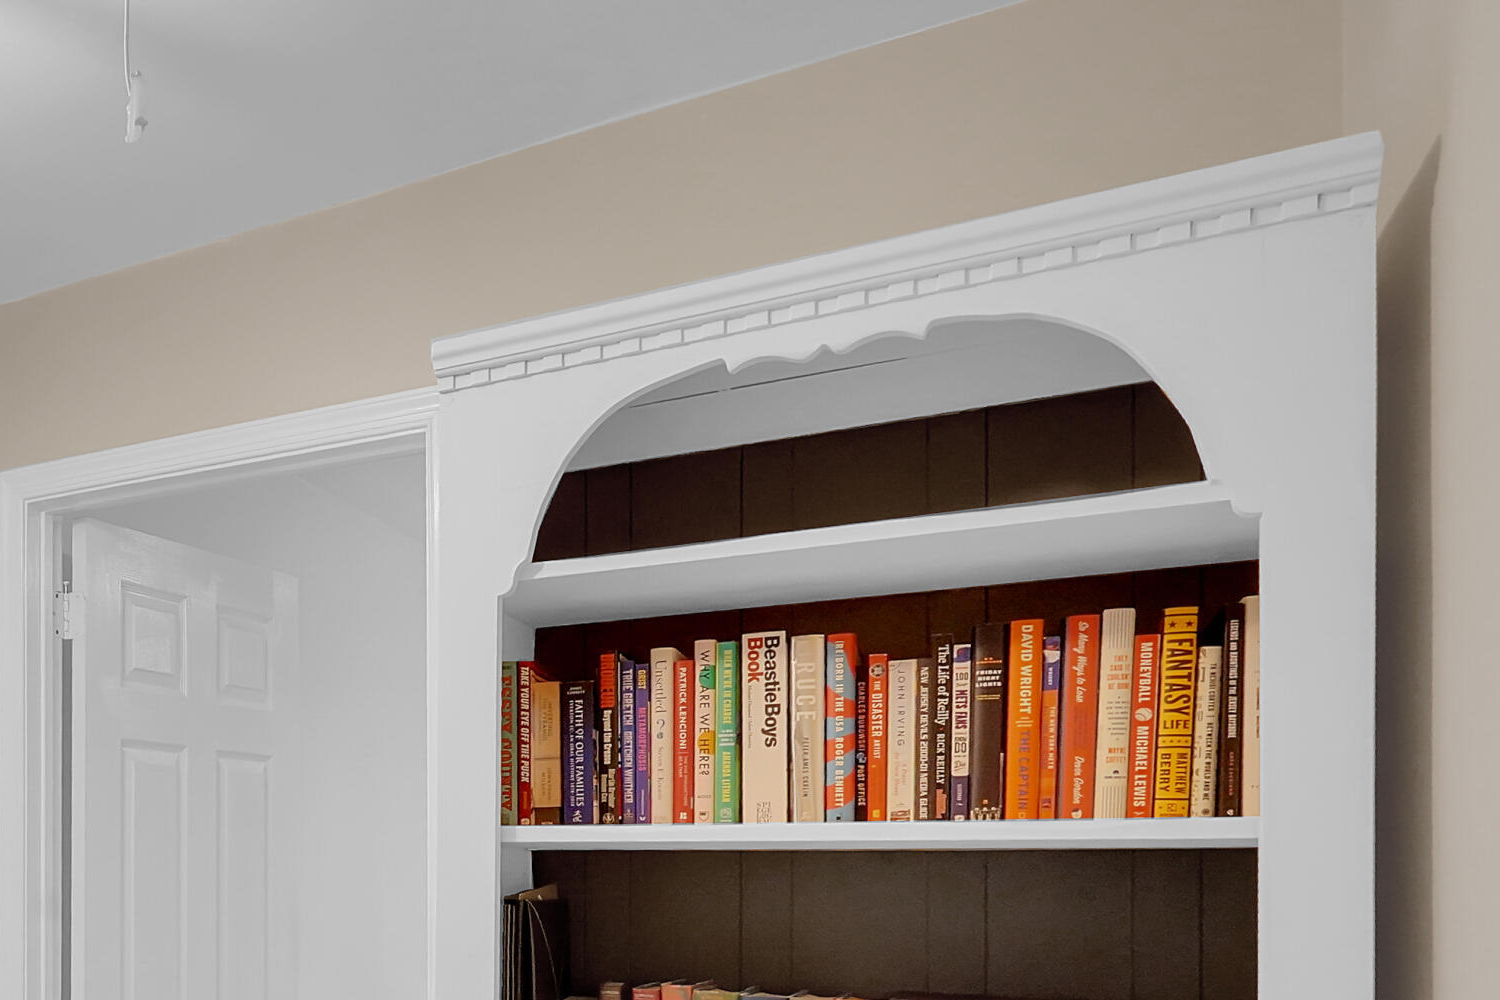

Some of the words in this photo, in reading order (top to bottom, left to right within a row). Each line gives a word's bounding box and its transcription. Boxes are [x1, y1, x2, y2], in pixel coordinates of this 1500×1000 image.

[937, 643, 949, 664] The
[1020, 624, 1034, 661] DAVID
[699, 650, 710, 683] WHY
[747, 637, 764, 684] Book
[920, 666, 929, 683] NEW
[1138, 641, 1153, 703] MONEYBALL
[521, 666, 530, 686] TAKE
[622, 669, 634, 692] TRUE
[654, 659, 667, 713] Unsettled
[679, 667, 687, 703] PATRICK
[872, 681, 881, 691] THE
[897, 669, 906, 700] JOHN
[937, 665, 949, 685] Life
[955, 672, 969, 681] 100
[1164, 638, 1195, 716] FANTASY
[521, 687, 530, 710] YOUR
[699, 685, 710, 709] ARE
[764, 635, 781, 748] BeastieBoys
[857, 682, 866, 713] CHARLES
[920, 685, 929, 713] JERSEY
[937, 686, 947, 697] of
[955, 689, 968, 709] METS
[1019, 665, 1033, 714] WRIGHT
[574, 699, 585, 727] FAITH
[622, 693, 634, 726] GRETCH
[835, 696, 844, 712] THE
[871, 693, 883, 737] DISASTER
[935, 698, 949, 726] Reilly
[520, 711, 530, 726] EYE
[679, 707, 687, 749] LENCIONI
[699, 714, 710, 733] WE
[835, 716, 844, 732] USA
[896, 705, 906, 747] IRVING
[919, 714, 929, 740] DEVILS
[955, 712, 968, 730] FANS
[1163, 720, 1190, 729] LIFE
[520, 727, 530, 742] OFF
[574, 728, 585, 741] OF
[857, 715, 866, 751] BUKOWSKI
[936, 733, 946, 754] RICK
[1018, 730, 1031, 755] THE
[520, 743, 530, 757] THE
[574, 742, 585, 763] OUR
[622, 731, 634, 769] GRETCHEN
[699, 739, 710, 775] HERE?
[835, 737, 844, 767] ROGER
[872, 739, 881, 759] ARTIST
[1134, 725, 1150, 774] MICHAEL
[520, 759, 530, 782] PUCK
[721, 751, 731, 777] AMANDA
[857, 765, 866, 781] POST
[936, 755, 946, 785] REILLY
[1160, 753, 1172, 793] BERRY
[1175, 752, 1189, 794] MATTHEW
[574, 765, 585, 807] FAMILIES
[622, 770, 634, 804] WHITMER
[835, 770, 844, 807] BENNETT
[857, 782, 866, 807] OFFICE
[919, 773, 929, 796] MEDIA
[1018, 757, 1030, 810] CAPTAIN
[1133, 777, 1148, 808] LEWIS
